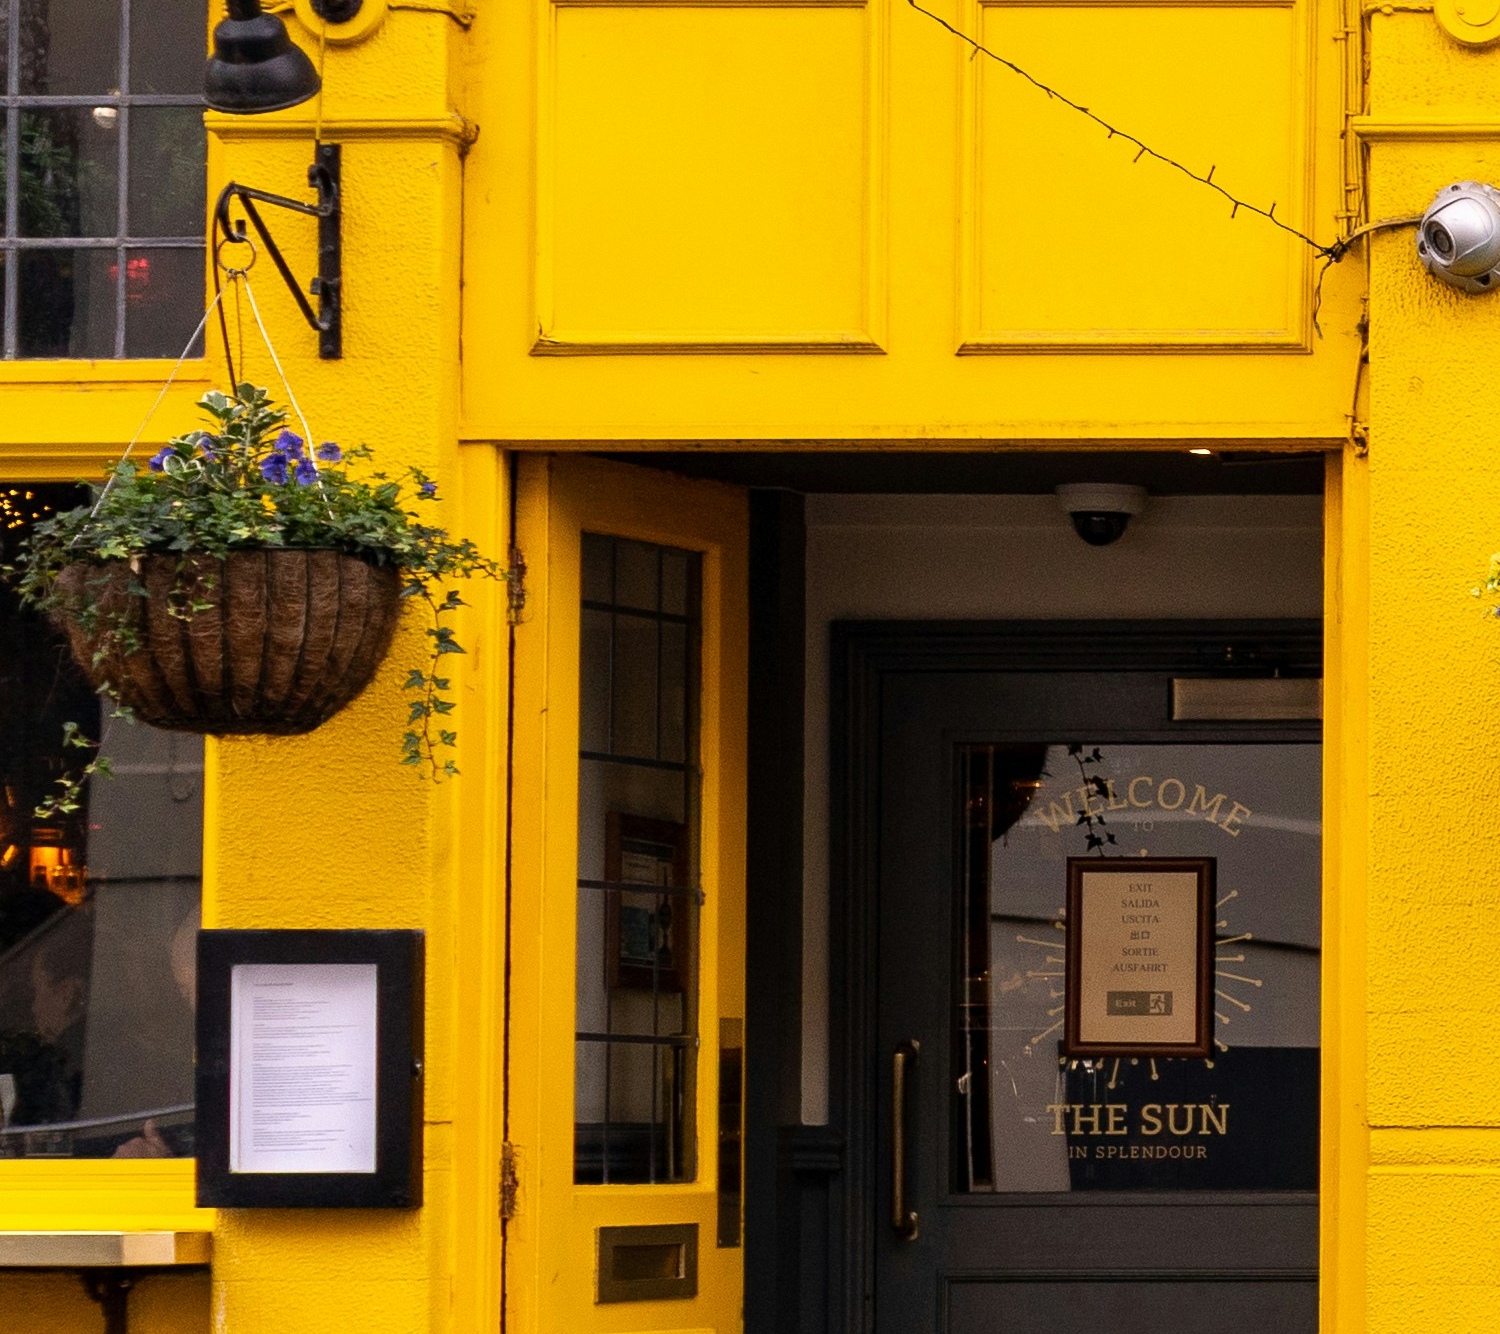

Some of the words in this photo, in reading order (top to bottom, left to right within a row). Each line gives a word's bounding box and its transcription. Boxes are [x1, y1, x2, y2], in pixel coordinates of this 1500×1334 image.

[1033, 775, 1254, 838] WELCOME
[1128, 883, 1153, 893] EXIT
[1121, 899, 1161, 908] SALIDA
[1121, 914, 1160, 924] USCITA
[1121, 947, 1159, 957] SORTIE
[1113, 963, 1168, 973] AUSFAHRT
[1046, 1104, 1128, 1136] THE
[1140, 1104, 1230, 1136] SUN
[1069, 1145, 1090, 1159] IN
[1096, 1145, 1208, 1160] SPLENDOUR
